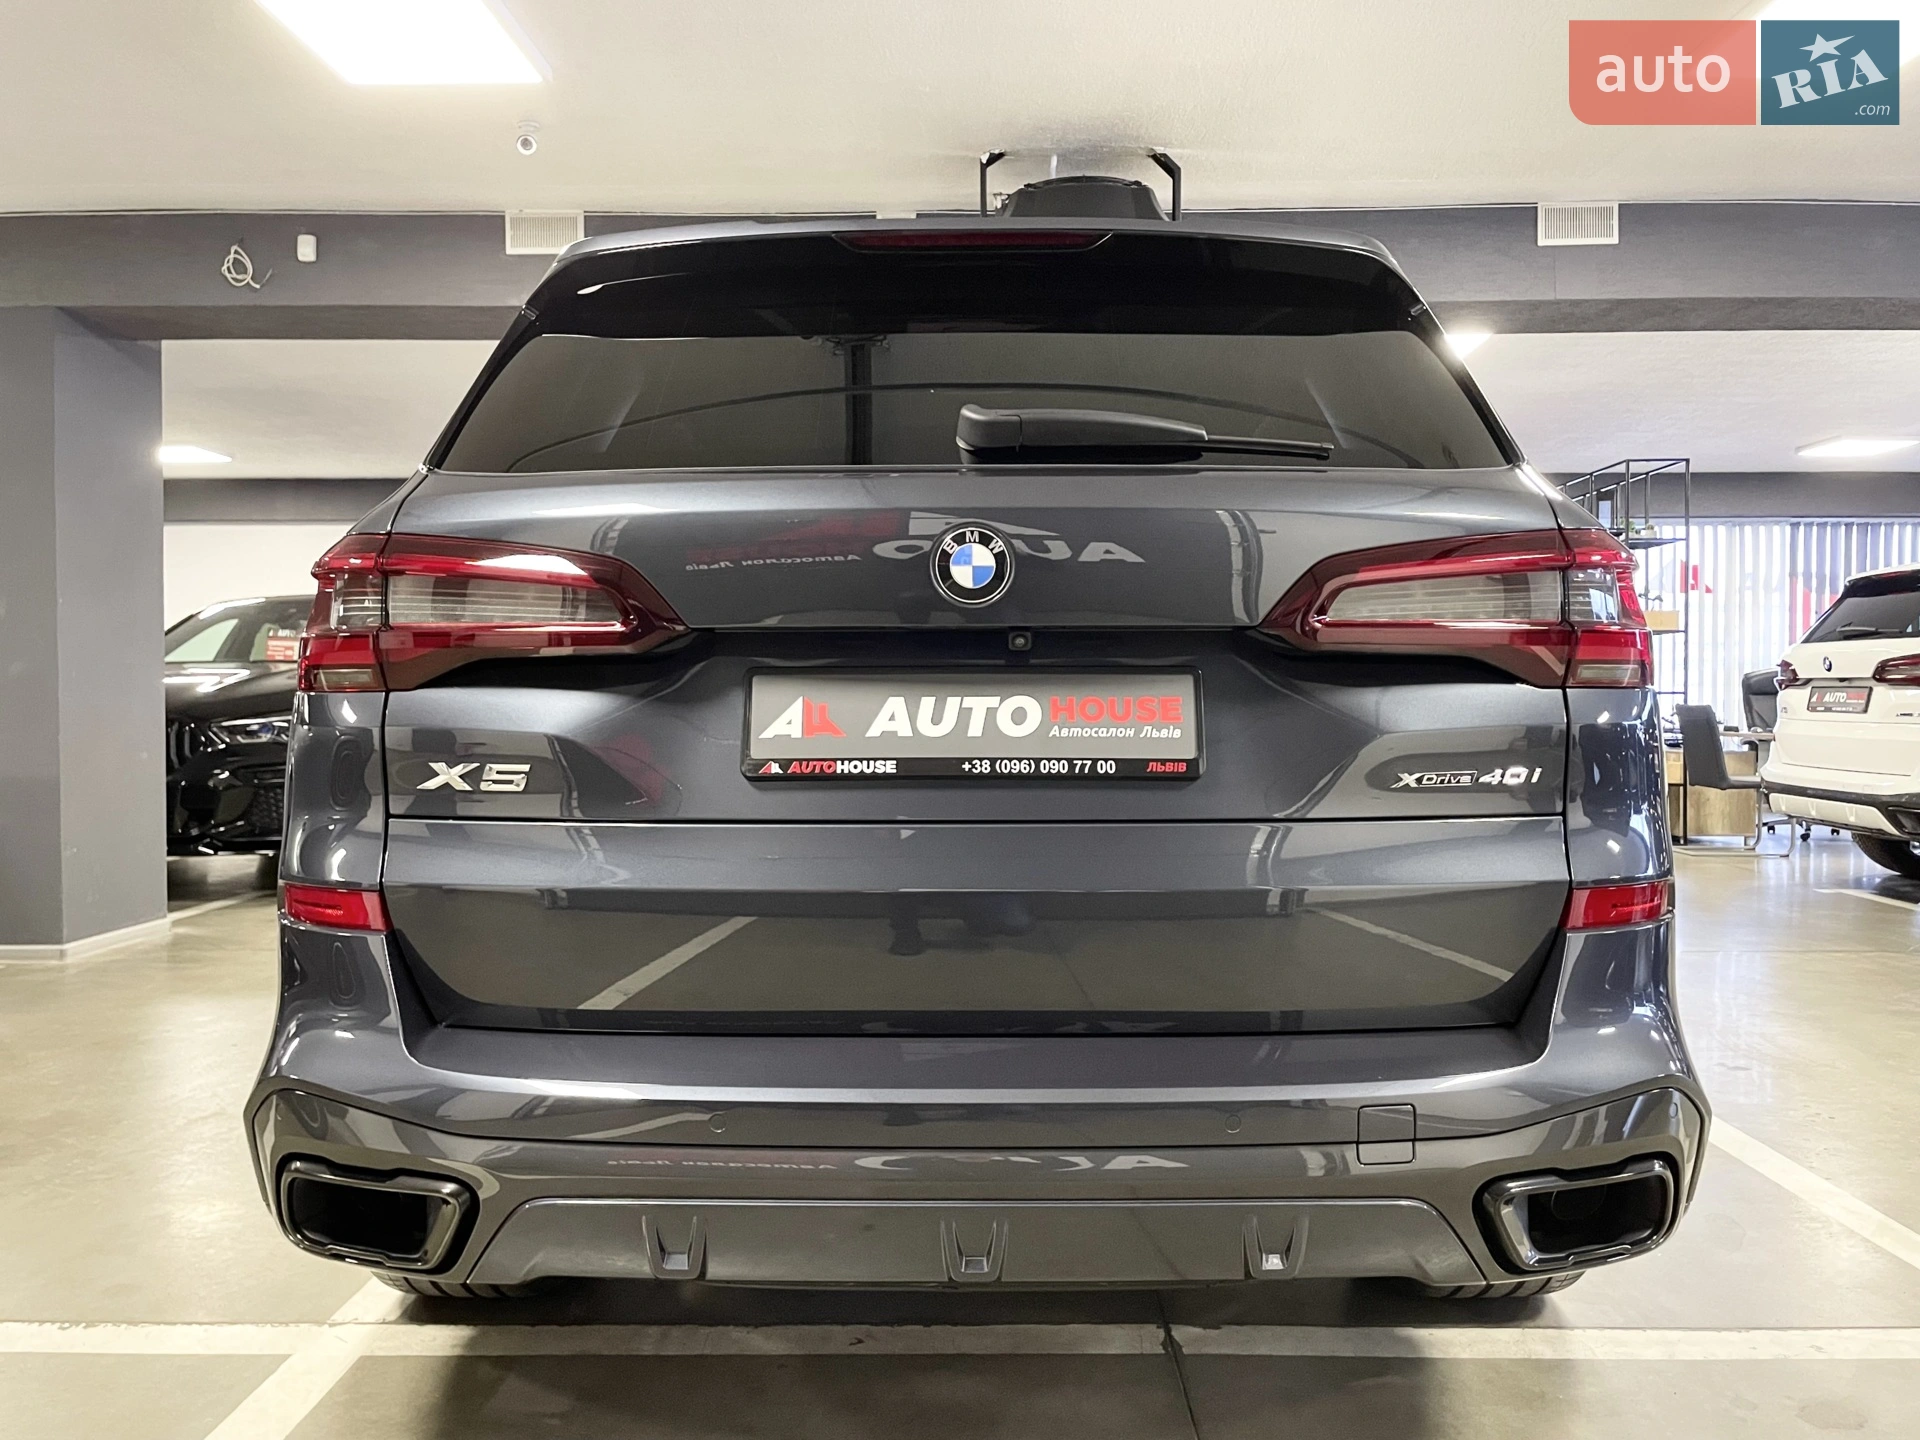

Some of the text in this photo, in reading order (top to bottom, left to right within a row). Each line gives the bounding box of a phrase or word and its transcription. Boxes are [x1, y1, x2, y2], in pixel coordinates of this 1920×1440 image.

[942, 530, 1004, 555] BMW
[1823, 692, 1847, 702] AUTO
[865, 695, 1043, 738] AUTO
[1049, 695, 1184, 724] HOUSE
[1049, 725, 1182, 739] Автосалон Львів
[961, 759, 1117, 775] +38 (096) 090 77 00
[1147, 762, 1187, 773] ЛЬВІВ
[416, 762, 531, 792] X5
